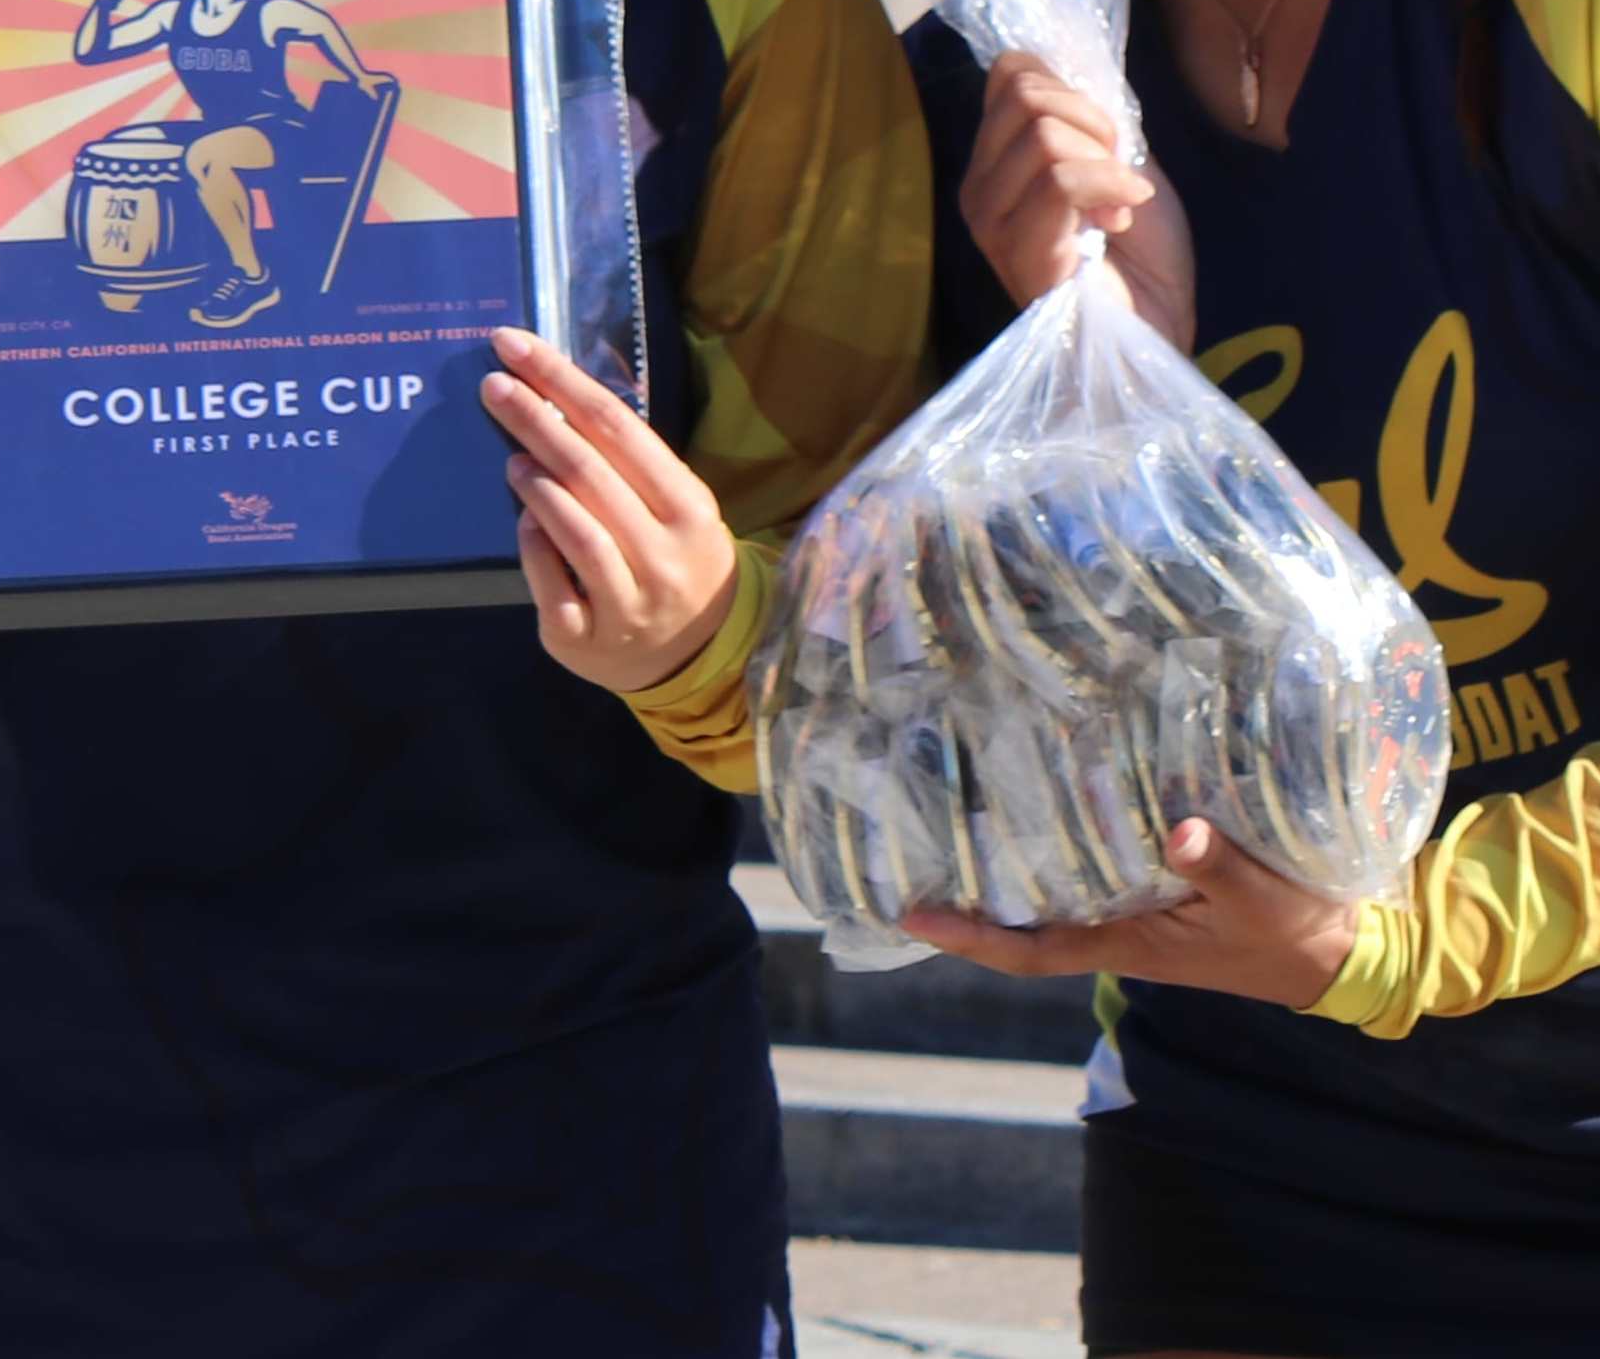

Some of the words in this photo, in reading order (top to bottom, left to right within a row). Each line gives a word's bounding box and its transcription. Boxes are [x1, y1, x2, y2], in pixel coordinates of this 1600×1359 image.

[178, 47, 253, 72] CDBA
[67, 343, 168, 359] CALIFORNIA
[174, 336, 304, 353] INTERNATIONAL
[309, 331, 383, 347] DRAGON
[388, 329, 432, 343] BOAT
[437, 326, 498, 340] FESTIVA
[63, 380, 300, 427] COLLEGE
[321, 374, 424, 414] CUP
[153, 434, 231, 454] FIRST
[248, 429, 340, 450] PLACE
